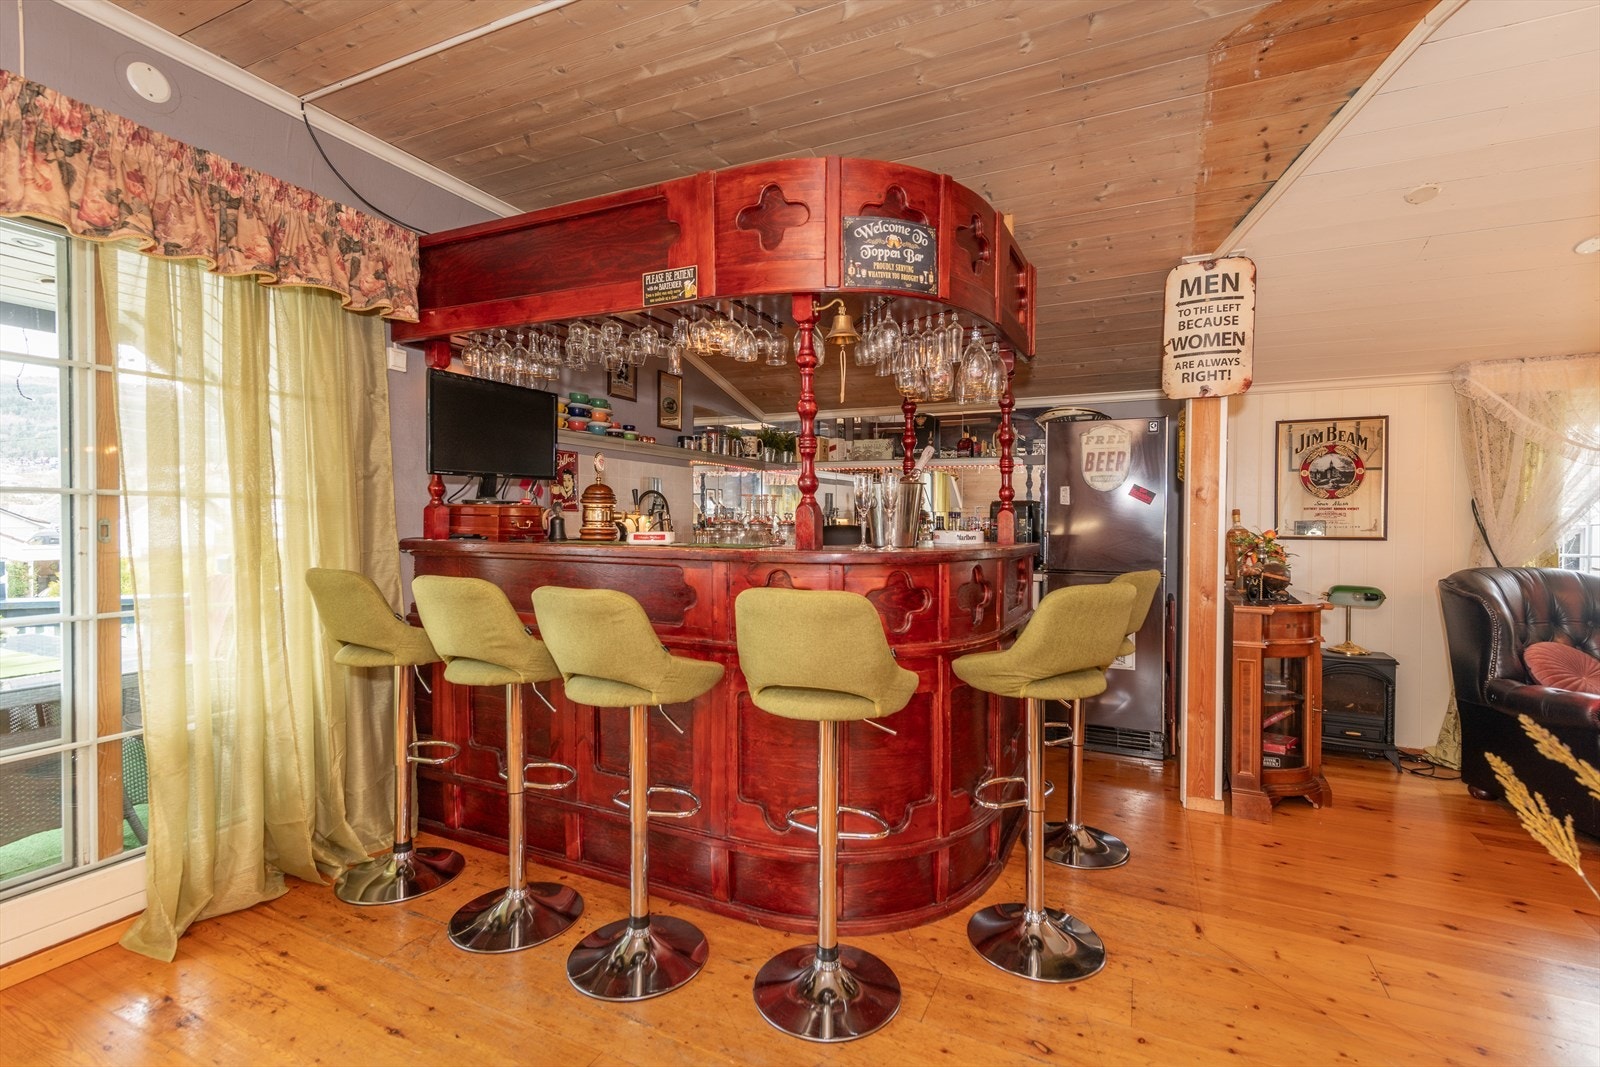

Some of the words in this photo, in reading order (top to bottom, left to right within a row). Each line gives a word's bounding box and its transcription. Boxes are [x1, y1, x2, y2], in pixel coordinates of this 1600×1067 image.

[854, 220, 911, 239] Welcome
[912, 228, 929, 246] To
[860, 244, 901, 262] Toppen
[903, 248, 924, 264] Bar
[868, 270, 891, 279] WHATEVER
[892, 272, 900, 280] YOU
[873, 262, 895, 271] PROUDLY
[895, 263, 914, 273] SERVING
[645, 272, 665, 285] PLEASE
[665, 271, 673, 282] BE
[673, 268, 695, 280] PATIENT
[659, 280, 682, 291] BARTENDER
[1179, 272, 1240, 298] MEN
[1178, 308, 1191, 317] TO
[1194, 305, 1213, 315] THE
[1216, 303, 1241, 313] LEFT
[1178, 315, 1239, 331] BECAUSE
[1171, 331, 1246, 352] WOMEN
[1175, 360, 1195, 370] ARE
[1197, 357, 1240, 368] ALWAYS
[1181, 369, 1232, 383] RIGHT!
[1084, 435, 1127, 445] FREE
[1295, 431, 1324, 454] JIM
[1326, 426, 1368, 450] BEAM
[1084, 451, 1126, 472] BEER
